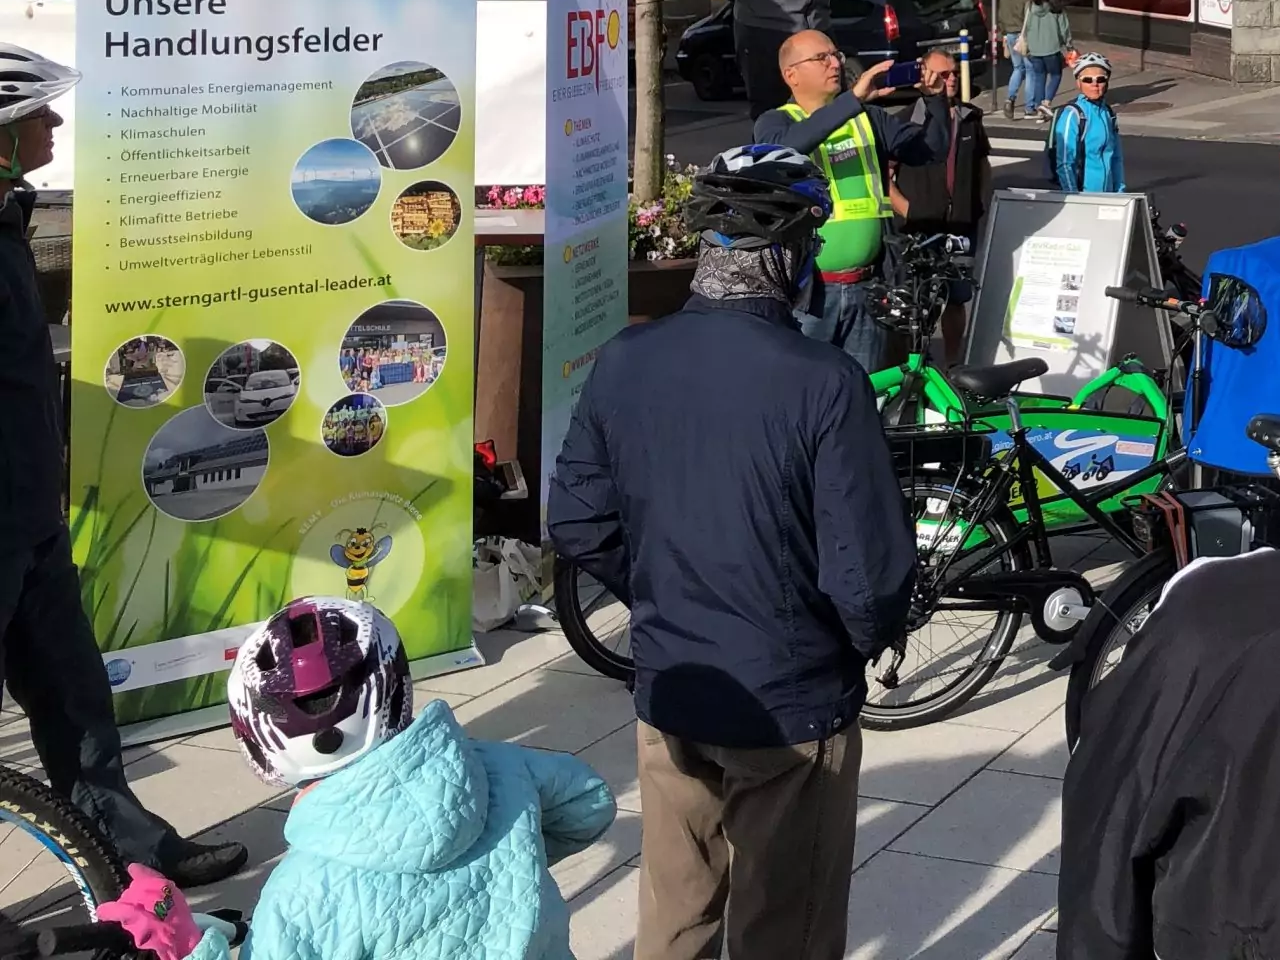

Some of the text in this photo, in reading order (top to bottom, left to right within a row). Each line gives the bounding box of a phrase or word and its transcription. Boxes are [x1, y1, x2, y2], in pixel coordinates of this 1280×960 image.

[105, 27, 384, 61] Handlungsfelder
[567, 9, 605, 96] EBF
[121, 80, 333, 97] Kommunales Energiemanagement
[121, 103, 258, 118] Nachhaltige Mobilität
[120, 126, 206, 140] Klimaschulen
[120, 144, 251, 162] Öffentlichkeitsarbeit
[120, 166, 249, 183] Erneuerbare Energie
[120, 189, 222, 206] Energieeffizienz
[119, 209, 238, 227] Klimafitte Betriebe
[119, 229, 253, 249] Bewusstseinsbildung
[119, 244, 312, 271] Umweltverträglicher Lebensstil
[105, 273, 392, 314] www.sterngartl-gusental-leader.at
[350, 324, 391, 332] TTELSCHULE
[0, 800, 89, 868] MAXXIS
